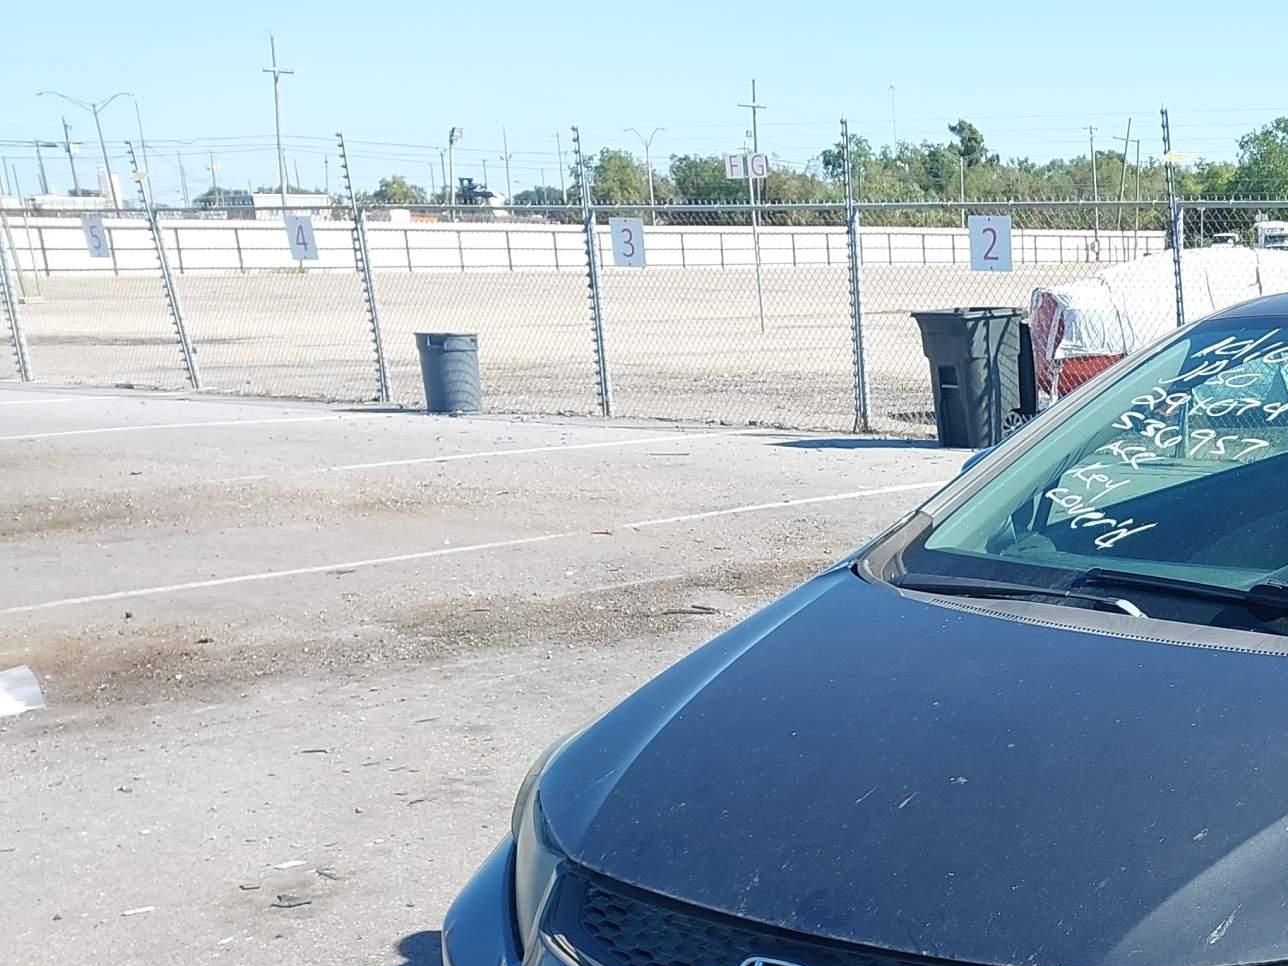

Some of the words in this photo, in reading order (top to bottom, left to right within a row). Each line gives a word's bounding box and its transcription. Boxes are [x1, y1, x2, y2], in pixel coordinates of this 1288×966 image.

[729, 154, 739, 177] F
[751, 154, 765, 177] G
[89, 225, 101, 249] 5
[295, 224, 309, 251] 4
[620, 228, 635, 258] 3
[982, 227, 1000, 261] 2
